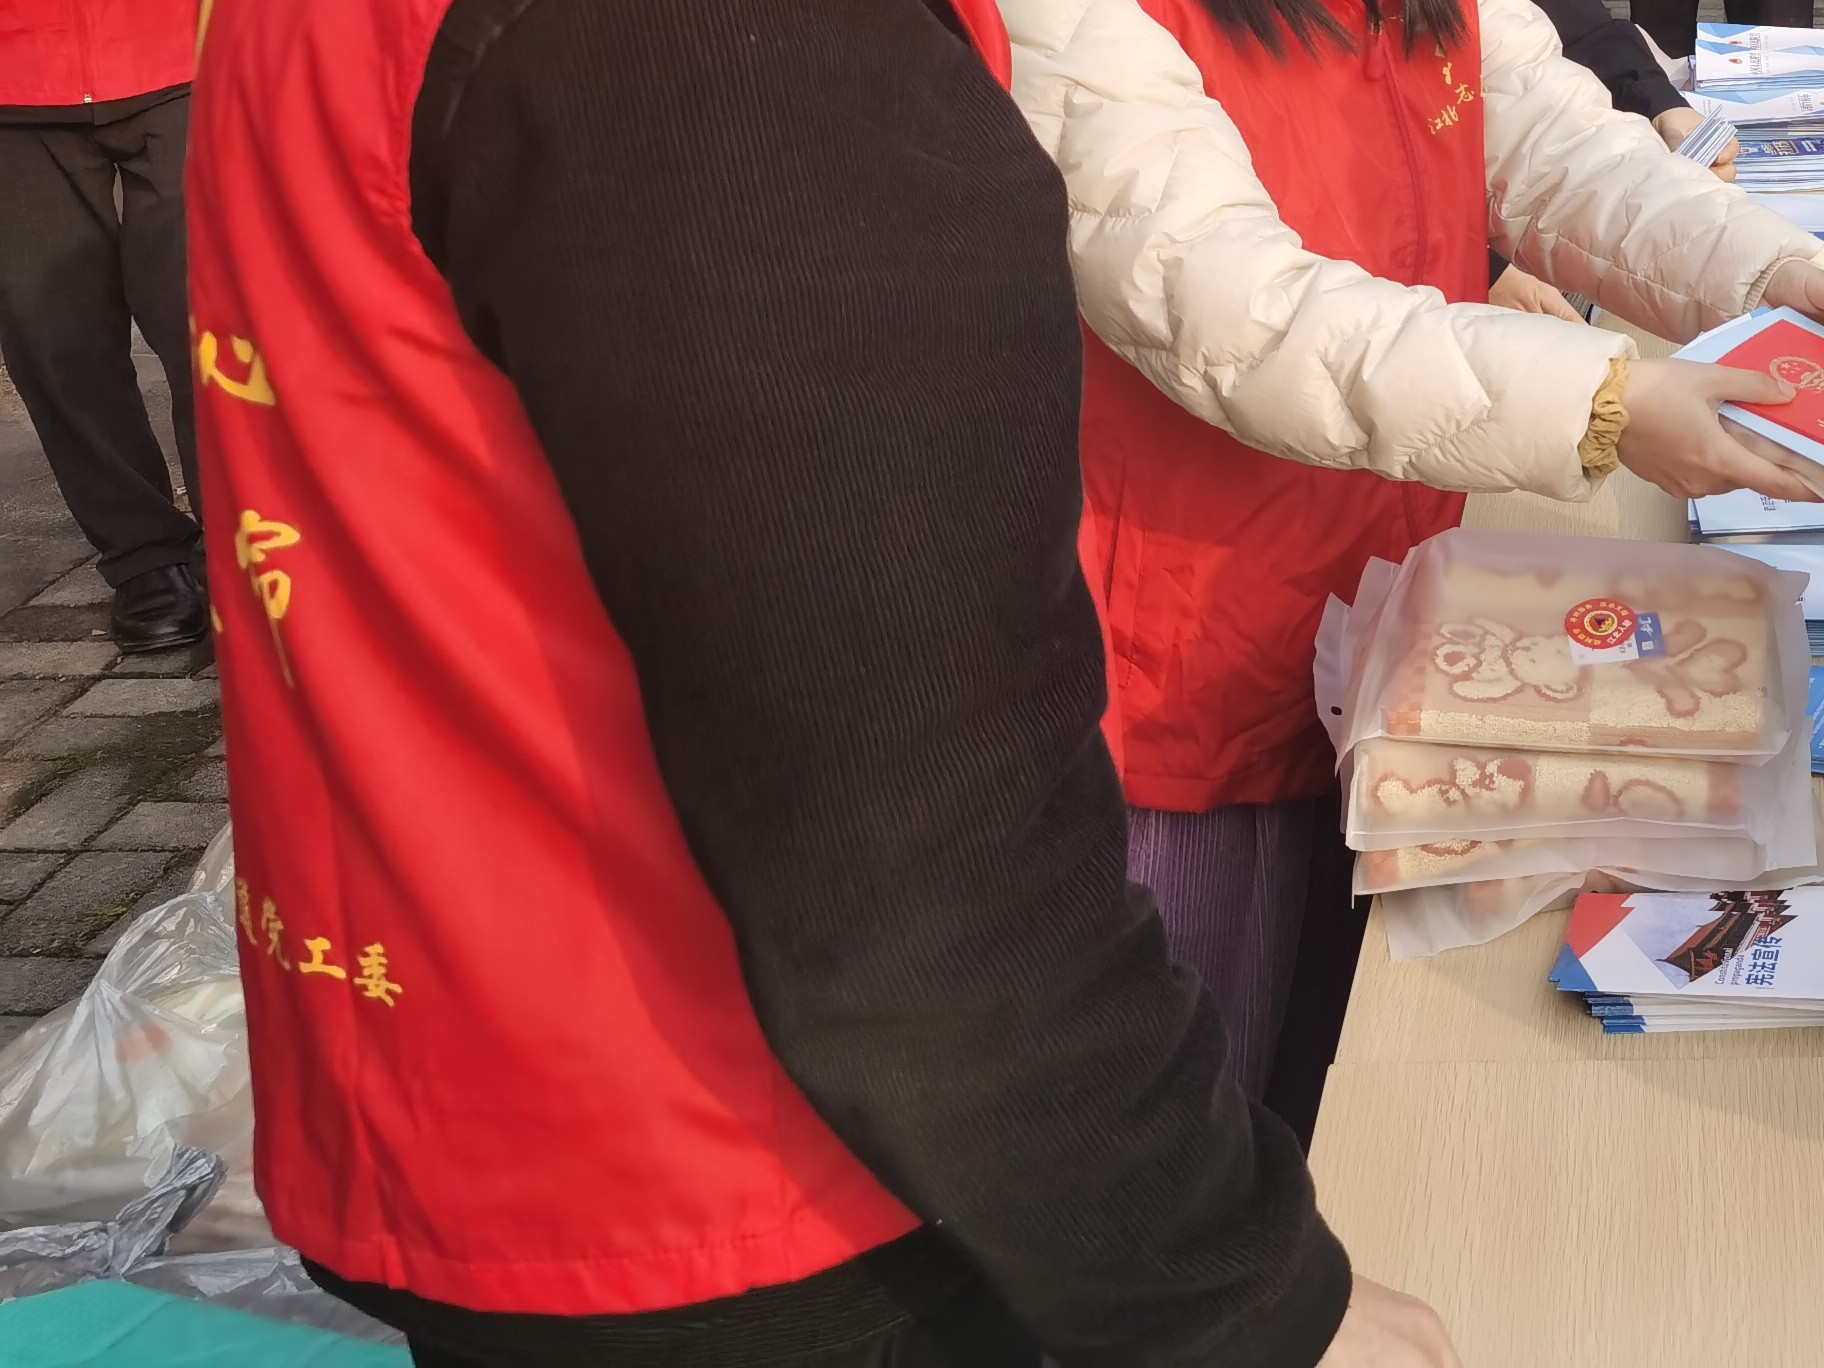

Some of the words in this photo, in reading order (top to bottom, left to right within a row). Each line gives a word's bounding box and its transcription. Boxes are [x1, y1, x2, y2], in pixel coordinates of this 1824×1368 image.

[1714, 947, 1734, 985] Constitutional
[1731, 954, 1745, 986] propaganda
[1745, 935, 1783, 986] 宪法宣传
